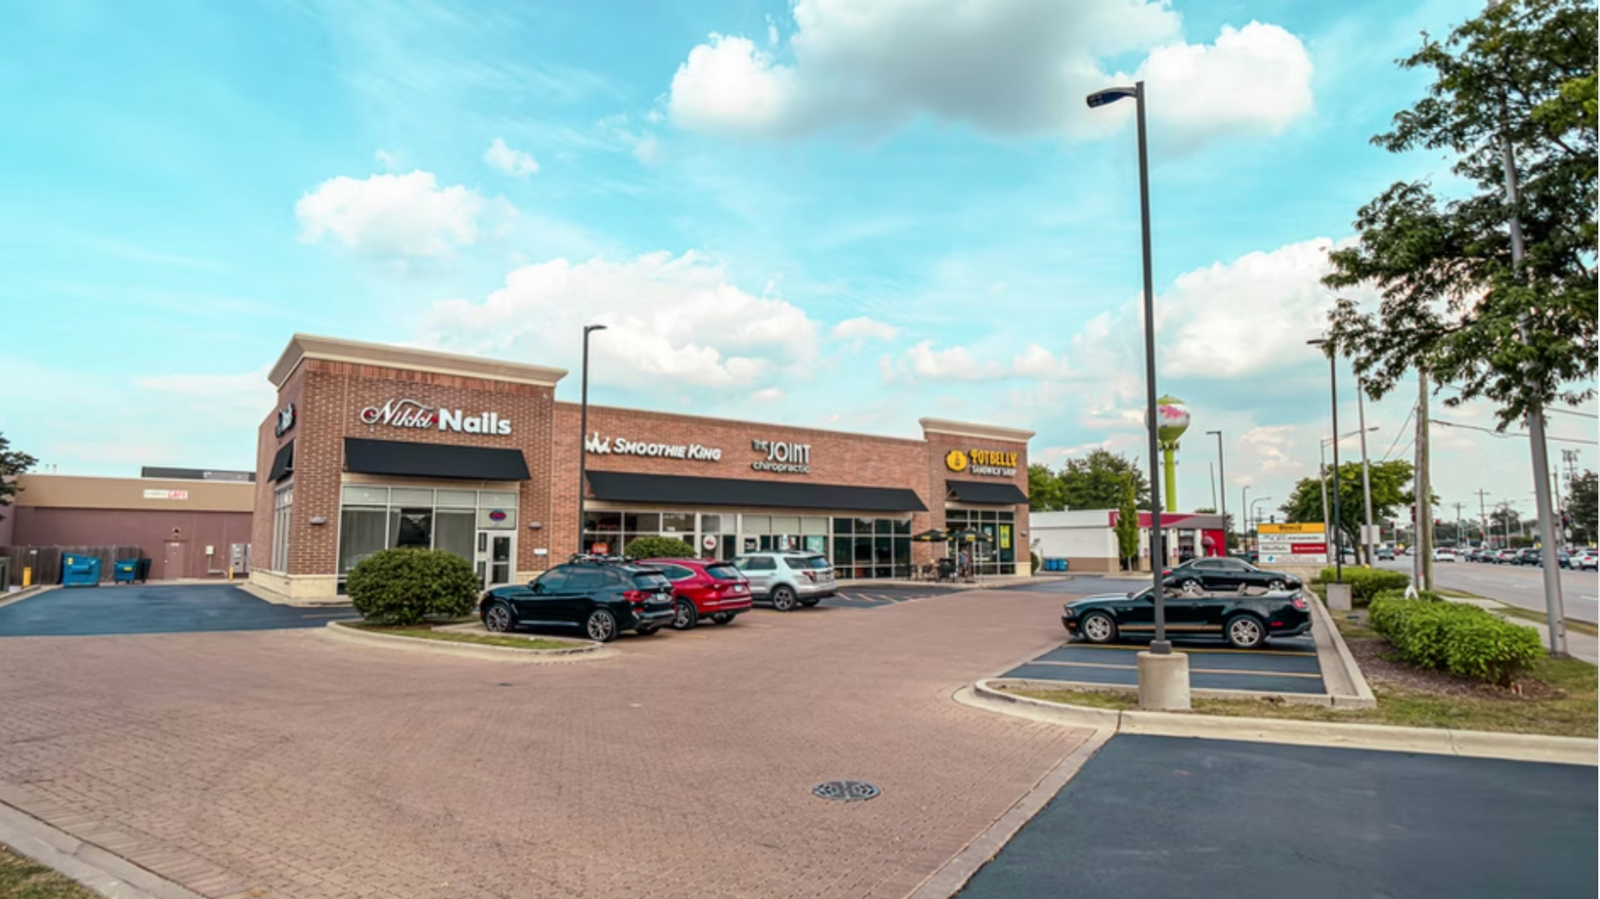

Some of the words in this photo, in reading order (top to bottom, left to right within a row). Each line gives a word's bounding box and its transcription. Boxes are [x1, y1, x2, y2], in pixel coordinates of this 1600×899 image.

[361, 399, 434, 429] Nikki
[438, 408, 512, 436] Nails
[613, 437, 685, 458] SMOOTHIE
[687, 444, 721, 460] KING
[767, 441, 810, 463] JOINT
[970, 449, 1017, 466] POTBELLY
[753, 461, 810, 473] chiropractic
[971, 465, 1001, 475] SANDWICH
[1002, 467, 1017, 477] SHOP
